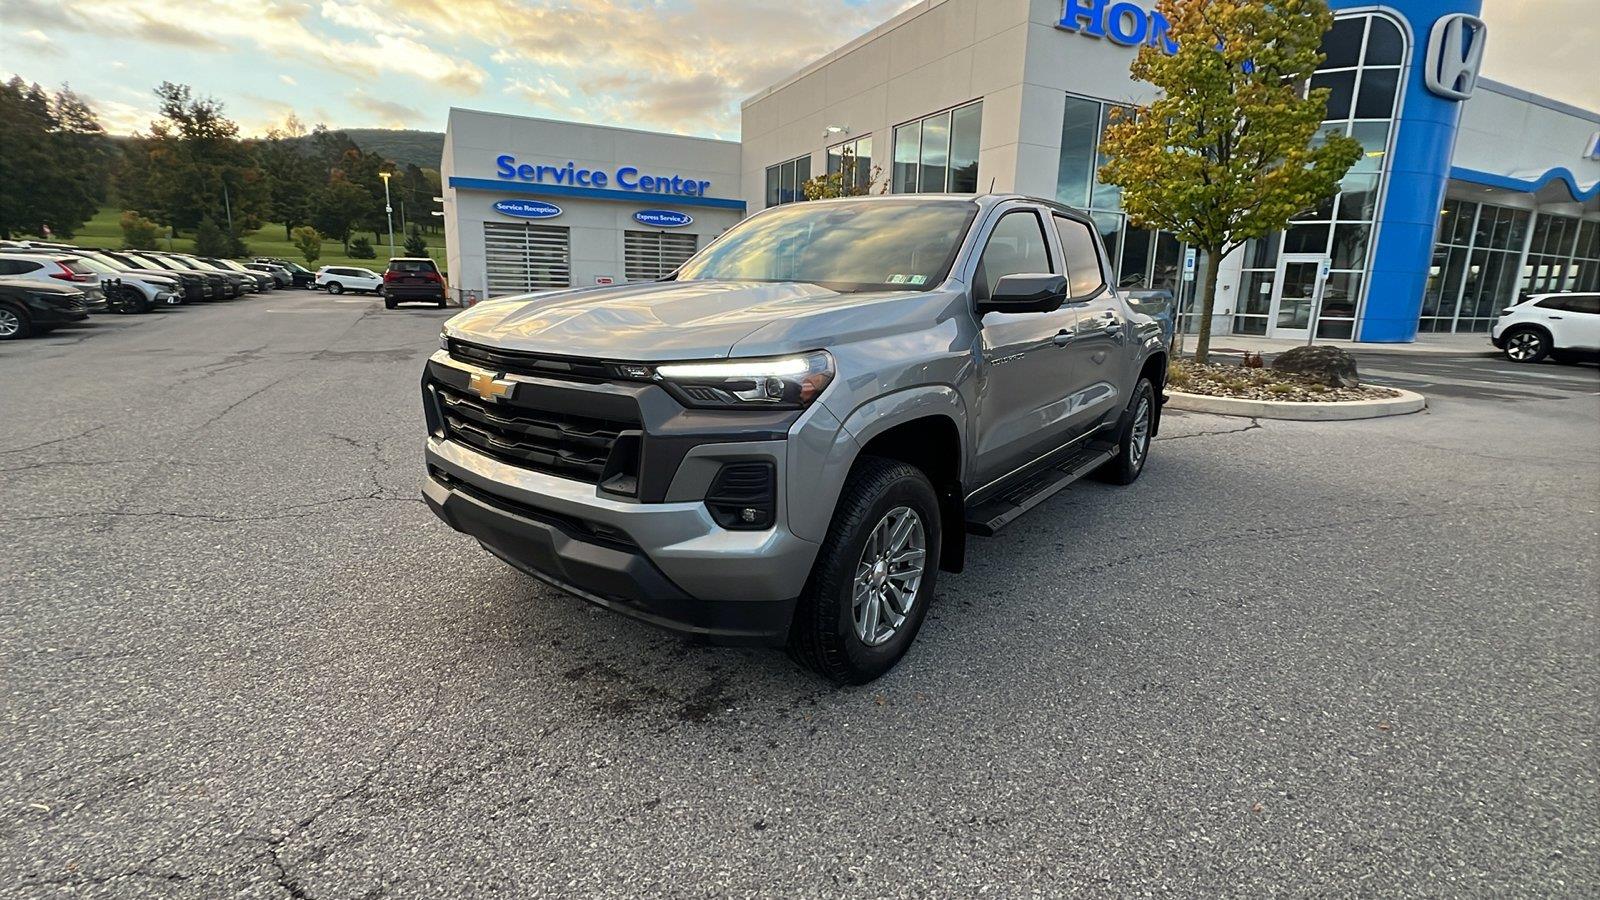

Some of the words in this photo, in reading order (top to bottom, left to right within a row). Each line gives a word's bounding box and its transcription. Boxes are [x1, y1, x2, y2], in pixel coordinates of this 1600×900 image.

[1057, 0, 1225, 55] HON
[496, 155, 608, 188] Service
[616, 167, 710, 196] Center
[496, 203, 523, 211] Service
[523, 205, 558, 214] Reception
[636, 213, 659, 221] Express
